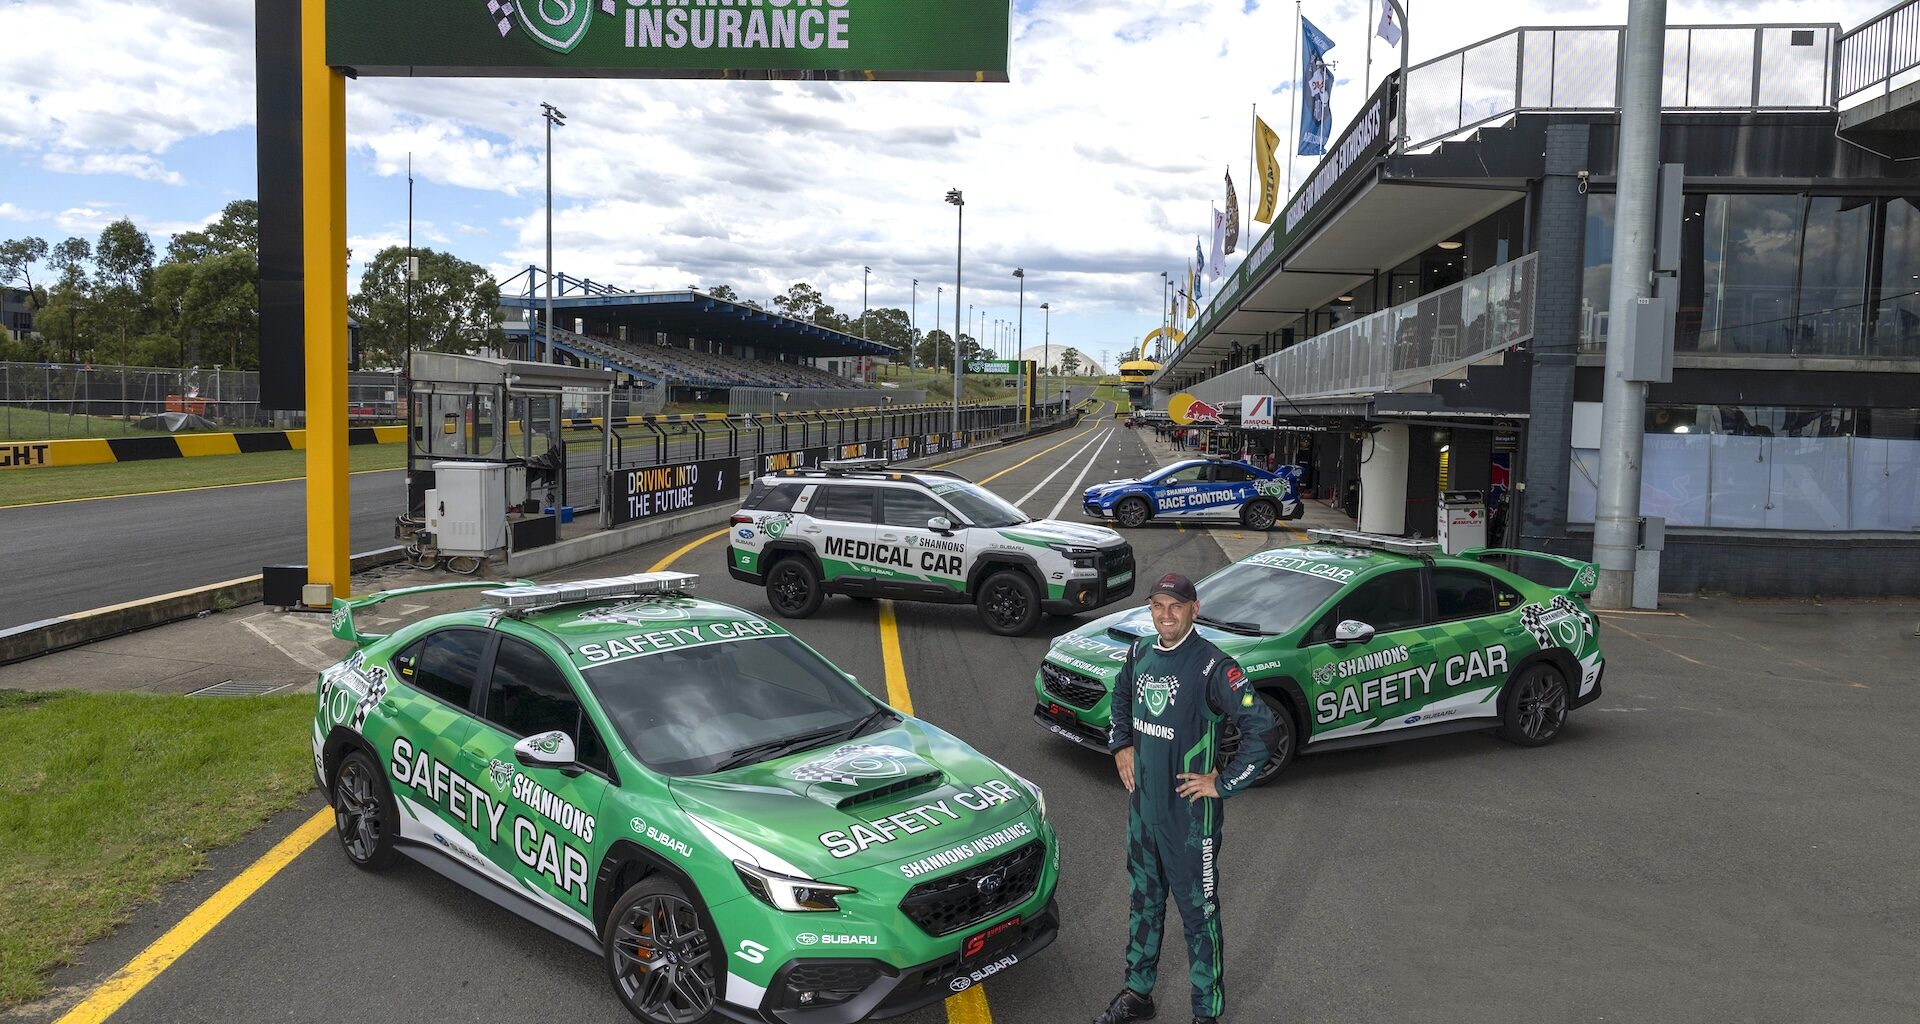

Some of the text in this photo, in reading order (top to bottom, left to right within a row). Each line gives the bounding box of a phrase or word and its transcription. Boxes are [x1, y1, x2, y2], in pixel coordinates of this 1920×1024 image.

[625, 9, 849, 49] INSURANCE
[1339, 98, 1381, 177] ENTHUSIASTS
[765, 451, 804, 471] DRIVING INTO
[628, 464, 698, 494] DRIVING INTO
[1166, 487, 1197, 496] SHANNONS
[628, 486, 694, 518] THE FUTURE
[1158, 488, 1246, 510] RACE CONTROL 1
[735, 539, 756, 547] SUBARU
[824, 536, 962, 576] MEDICAL CAR
[919, 537, 965, 552] SHANNONS
[870, 568, 894, 576] SUBARU
[1247, 555, 1354, 580] SAFETY CAR
[579, 620, 776, 662] SAFETY CAR
[1071, 659, 1109, 677] INSURANCE
[1246, 660, 1281, 673] SUBARU
[1337, 645, 1409, 678] SHANNONS
[1316, 644, 1509, 725] SAFETY CAR
[1133, 717, 1175, 740] HANNONS
[1422, 709, 1457, 721] SUBARU
[391, 736, 589, 904] SAFETY CAR
[512, 771, 596, 844] SHANNONS
[818, 779, 1022, 860] SAFETY CAR
[647, 826, 693, 858] SUBARU
[899, 843, 975, 879] SHANNONS
[973, 821, 1031, 854] INSURANCE
[1202, 838, 1214, 899] SHANNONS
[822, 934, 877, 945] SUBARU
[969, 954, 1019, 983] SUBARU
